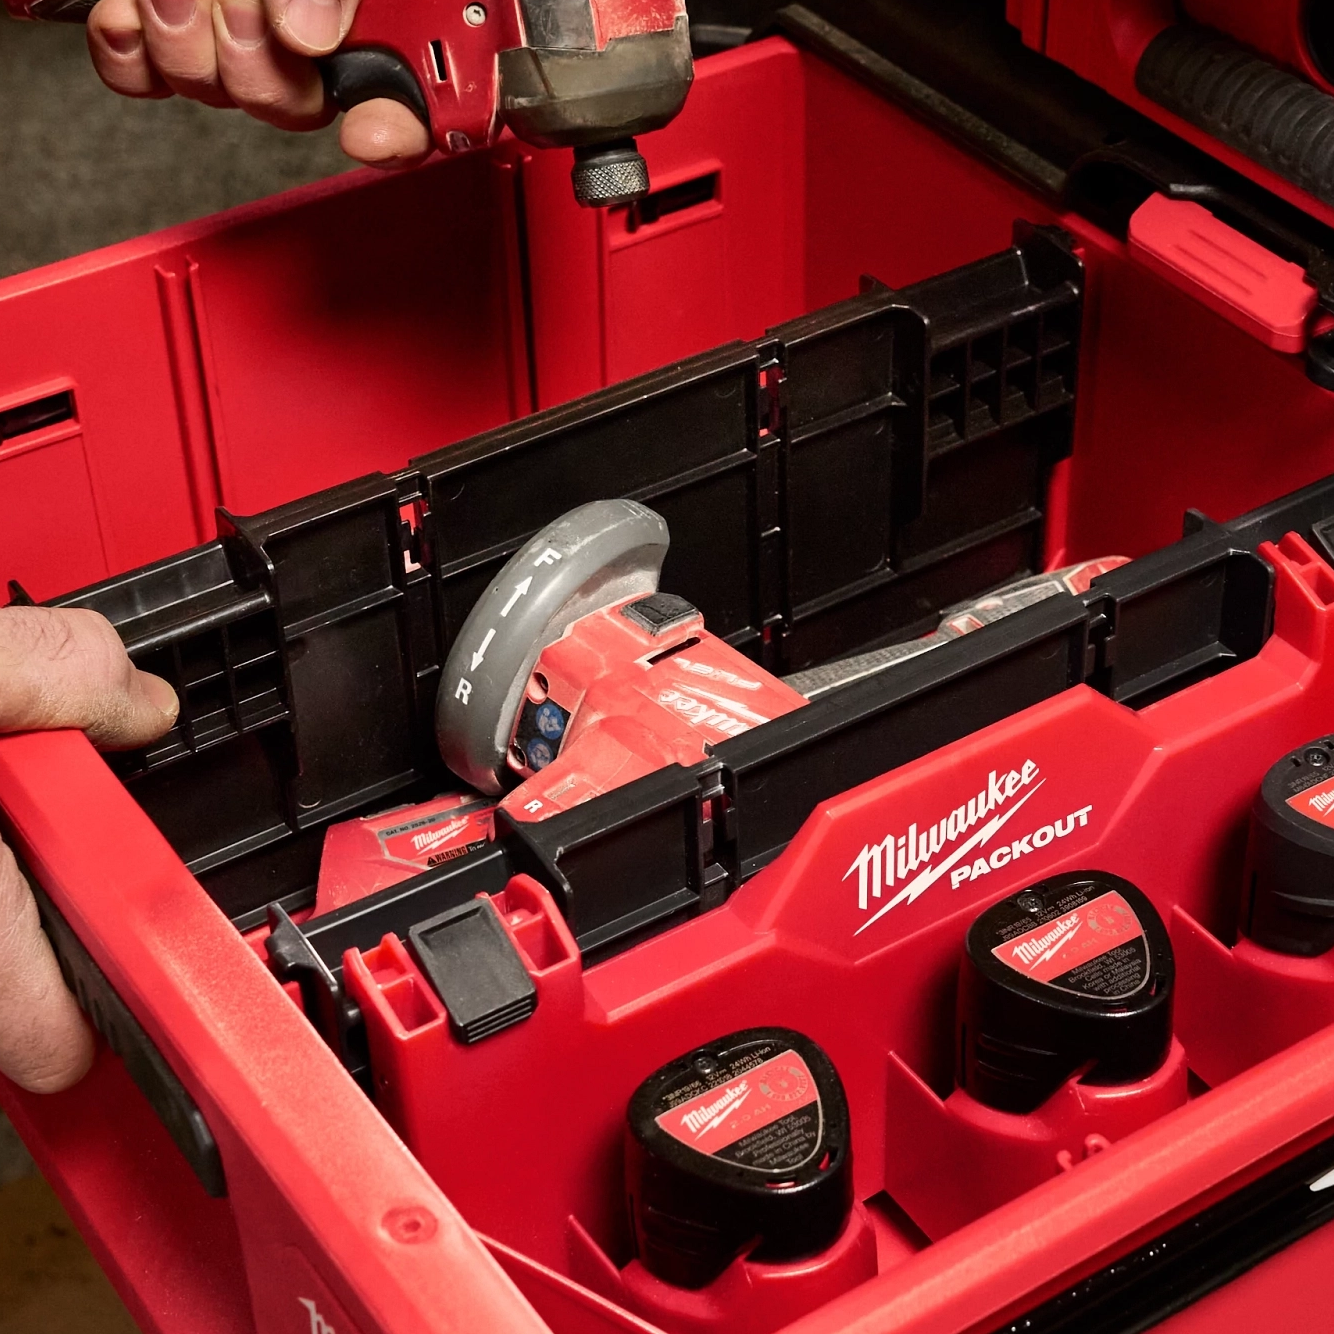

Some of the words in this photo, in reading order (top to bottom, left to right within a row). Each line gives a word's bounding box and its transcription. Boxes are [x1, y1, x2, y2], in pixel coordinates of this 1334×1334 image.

[533, 547, 563, 568] F
[455, 677, 473, 706] R
[524, 798, 543, 814] R
[410, 815, 469, 850] Milwaukee
[842, 758, 1041, 909] Milwaukee
[434, 845, 467, 862] WARNING
[949, 804, 1093, 890] PACKOUT
[1012, 912, 1080, 965] Milwaukee
[1068, 961, 1104, 984] Brookfield,
[1081, 974, 1104, 991] Korea
[1111, 956, 1142, 976] Malaysia
[1084, 968, 1104, 983] Cells
[1102, 958, 1123, 974] made
[1092, 979, 1109, 992] with
[1107, 963, 1141, 985] additional
[1103, 970, 1141, 995] processing
[1119, 976, 1141, 992] China
[729, 1054, 752, 1070] 24Wh
[679, 1079, 750, 1133] Milwaukee
[751, 1127, 804, 1158] Professionally
[751, 1150, 778, 1167] made
[782, 1133, 806, 1150] China
[768, 1141, 809, 1166] Milwaukee
[786, 1152, 804, 1166] Tool
